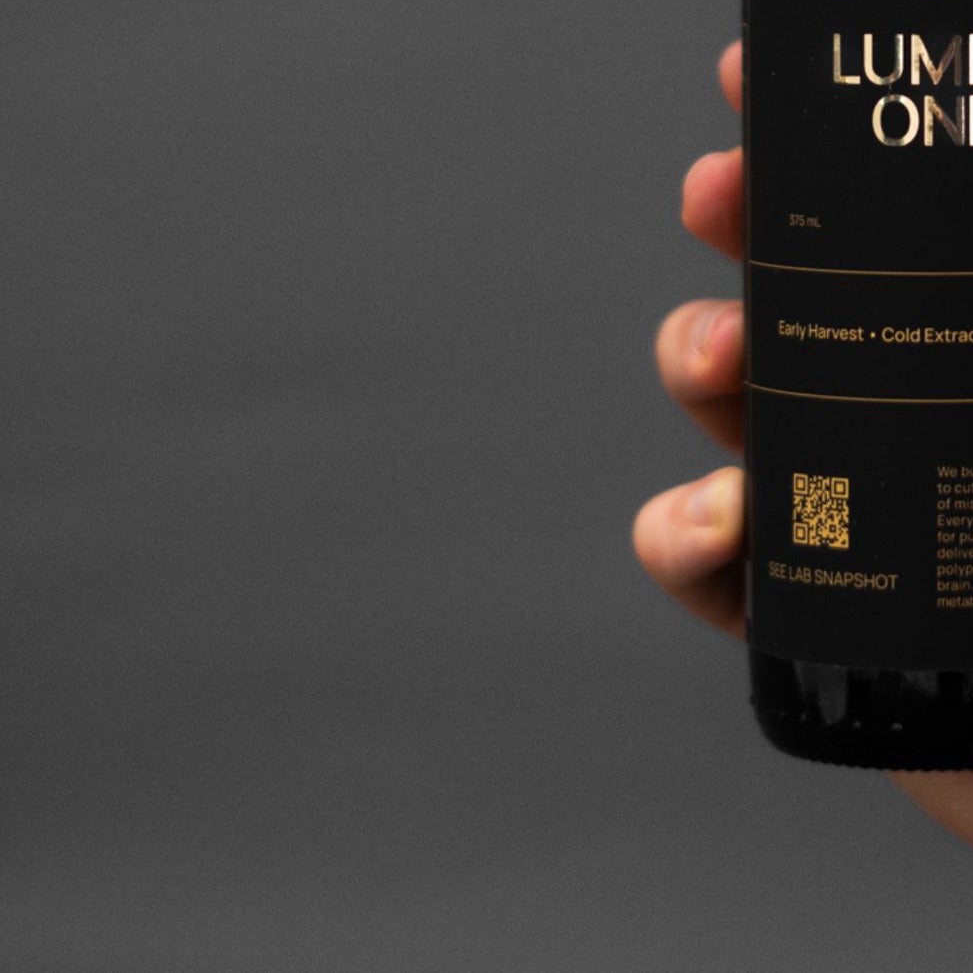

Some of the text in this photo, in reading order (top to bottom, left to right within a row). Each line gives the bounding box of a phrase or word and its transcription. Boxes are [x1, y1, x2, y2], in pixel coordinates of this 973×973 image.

[807, 215, 822, 228] mL
[778, 320, 806, 341] Early
[808, 324, 863, 341] Harvest
[882, 327, 920, 343] Cold
[938, 466, 957, 477] We
[937, 483, 951, 494] to
[937, 498, 951, 510] of
[937, 514, 973, 527] Every
[938, 531, 955, 542] for
[768, 561, 899, 590] SEE LAB SNAPSHOT
